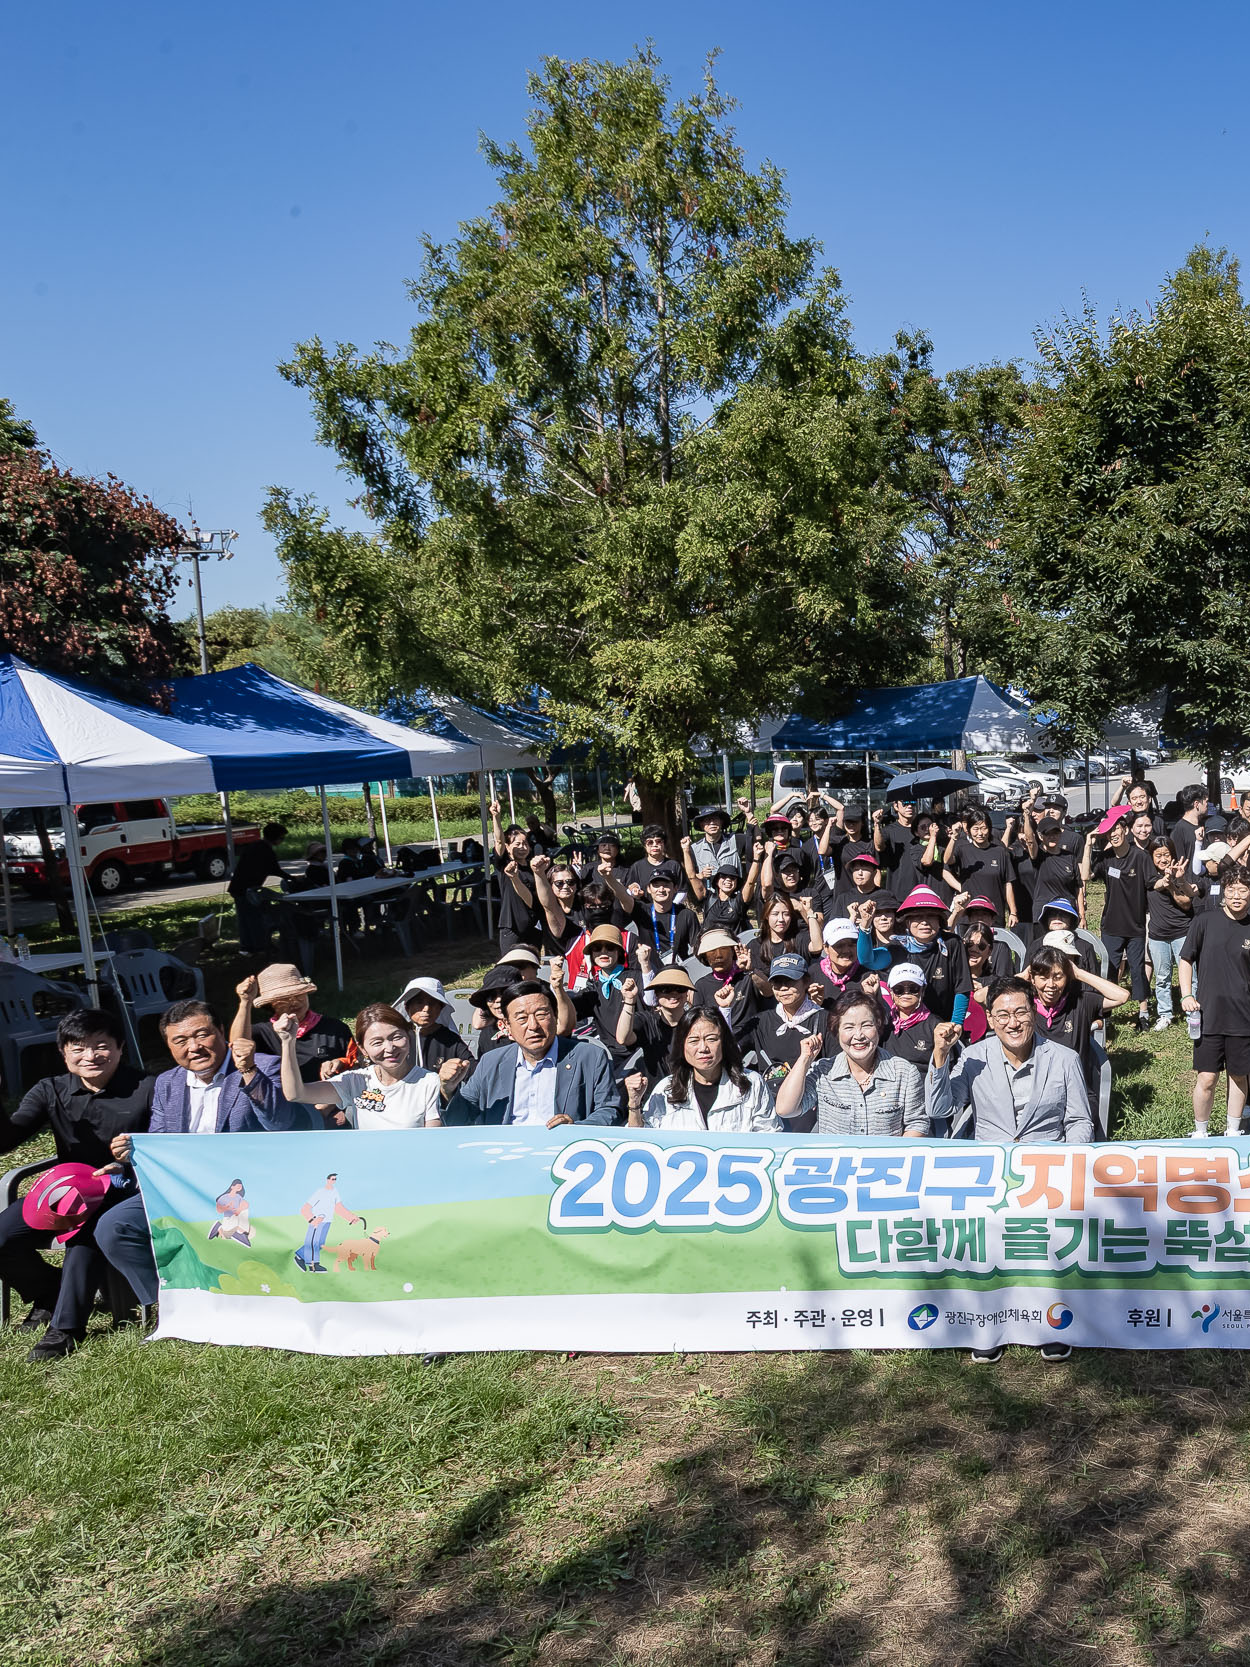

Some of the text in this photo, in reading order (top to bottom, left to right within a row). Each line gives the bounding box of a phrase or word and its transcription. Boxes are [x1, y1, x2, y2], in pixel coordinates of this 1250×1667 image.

[559, 1148, 764, 1218] 2025
[783, 1154, 997, 1215] 광진구
[845, 1216, 987, 1264] 다함께
[1000, 1216, 1151, 1263] 즐기는
[745, 1307, 874, 1329] 주최 주관 운영
[944, 1308, 1043, 1329] 광진구장애인체육회
[1126, 1307, 1161, 1328] 후원
